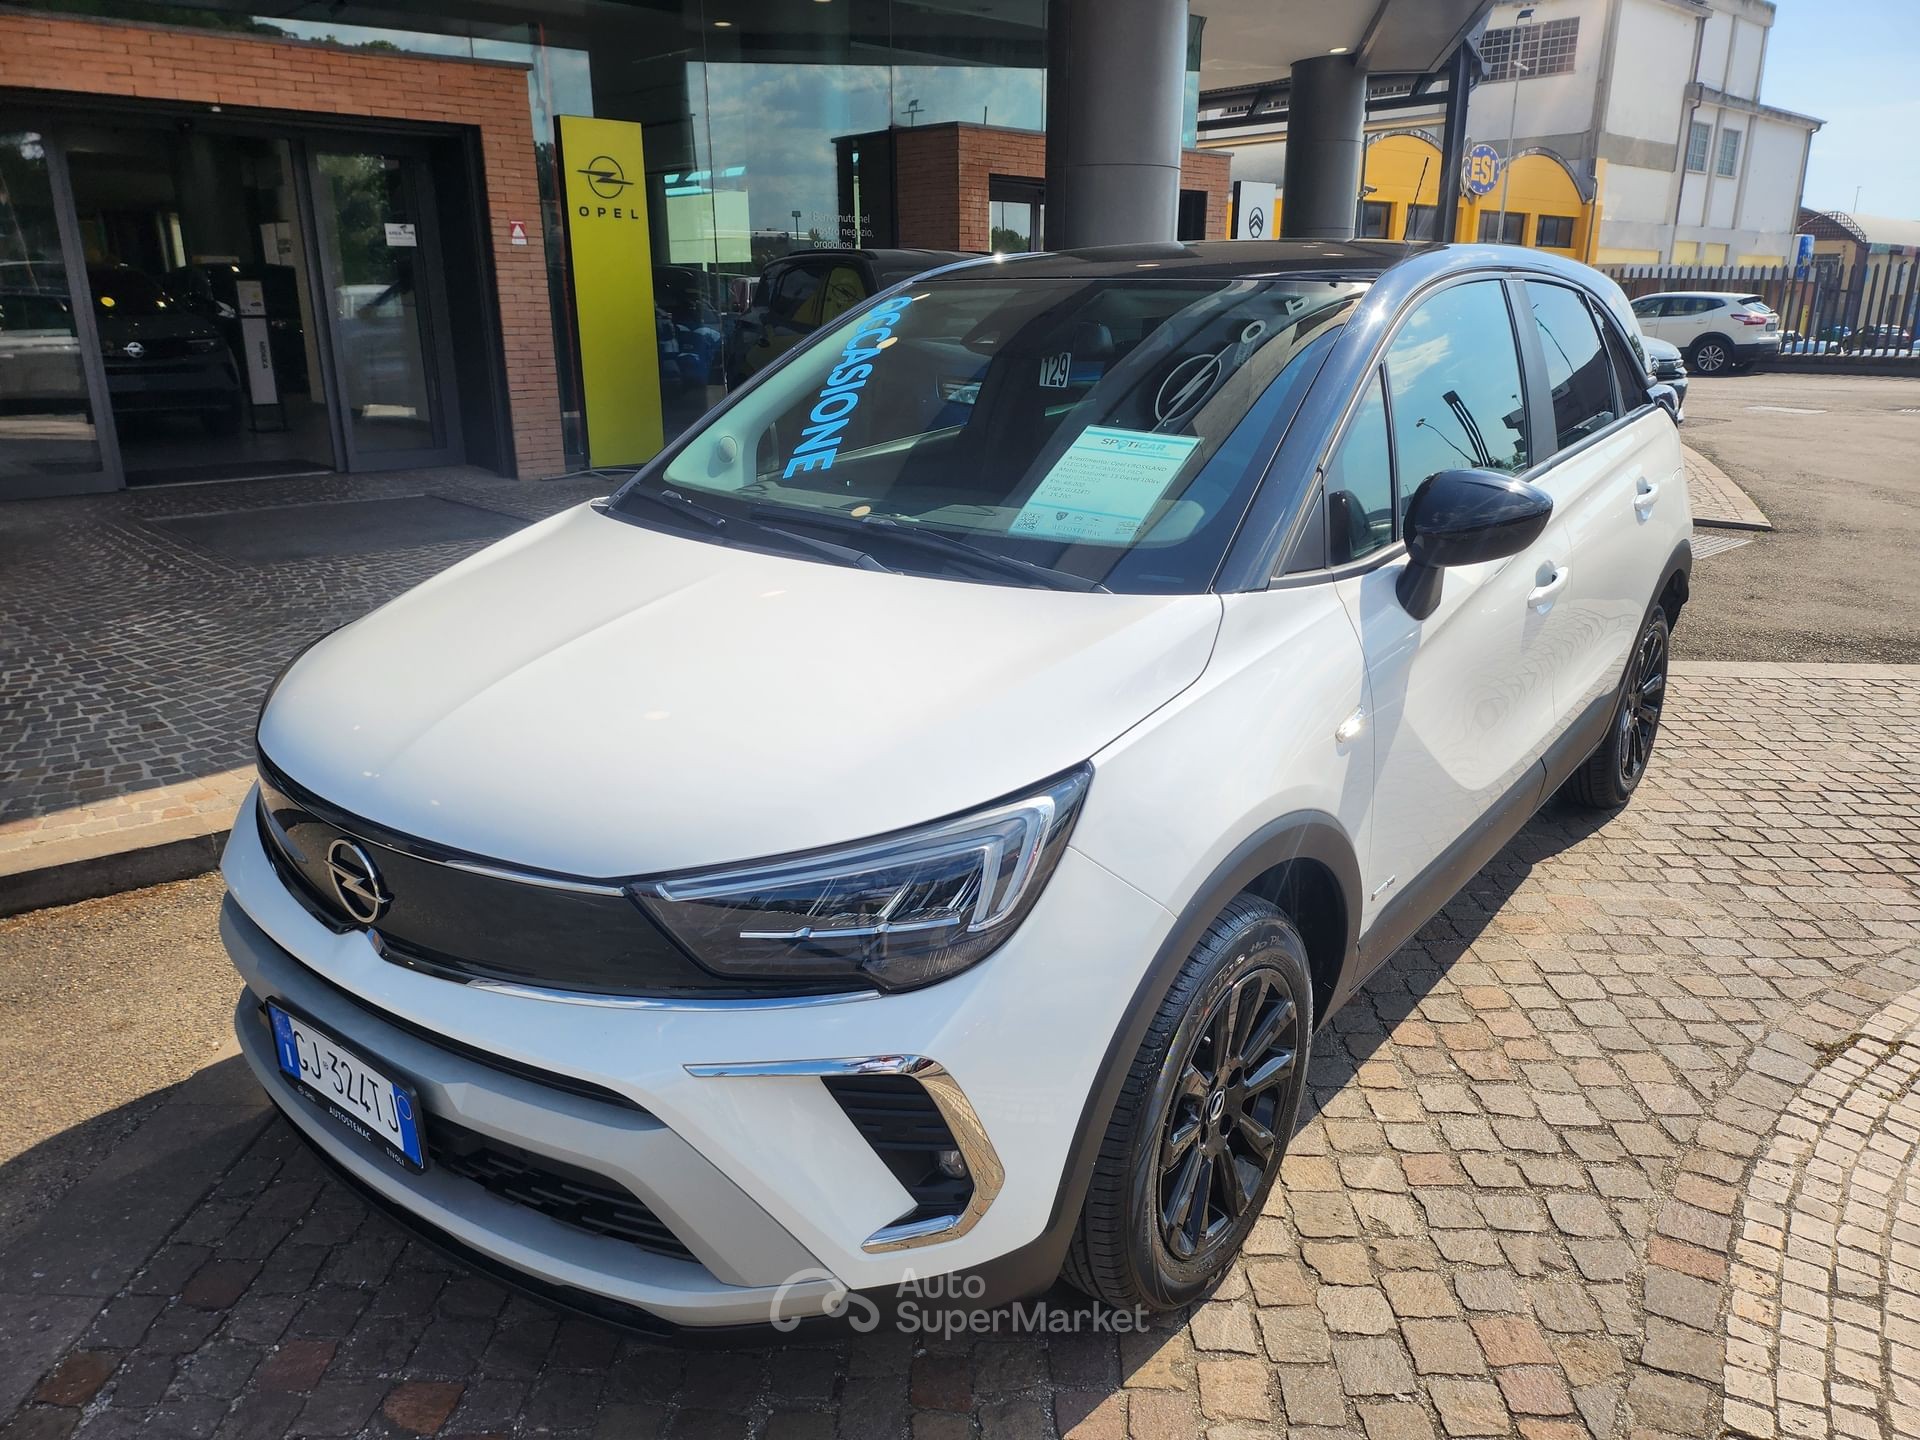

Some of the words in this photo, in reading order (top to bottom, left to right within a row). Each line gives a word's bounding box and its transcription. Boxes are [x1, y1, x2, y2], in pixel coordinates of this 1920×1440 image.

[1471, 155, 1496, 185] ESI
[579, 206, 639, 219] OPEL
[1043, 353, 1069, 387] 129
[783, 296, 912, 479] OCCASIONE
[328, 1106, 373, 1142] AUTOSTEMAC
